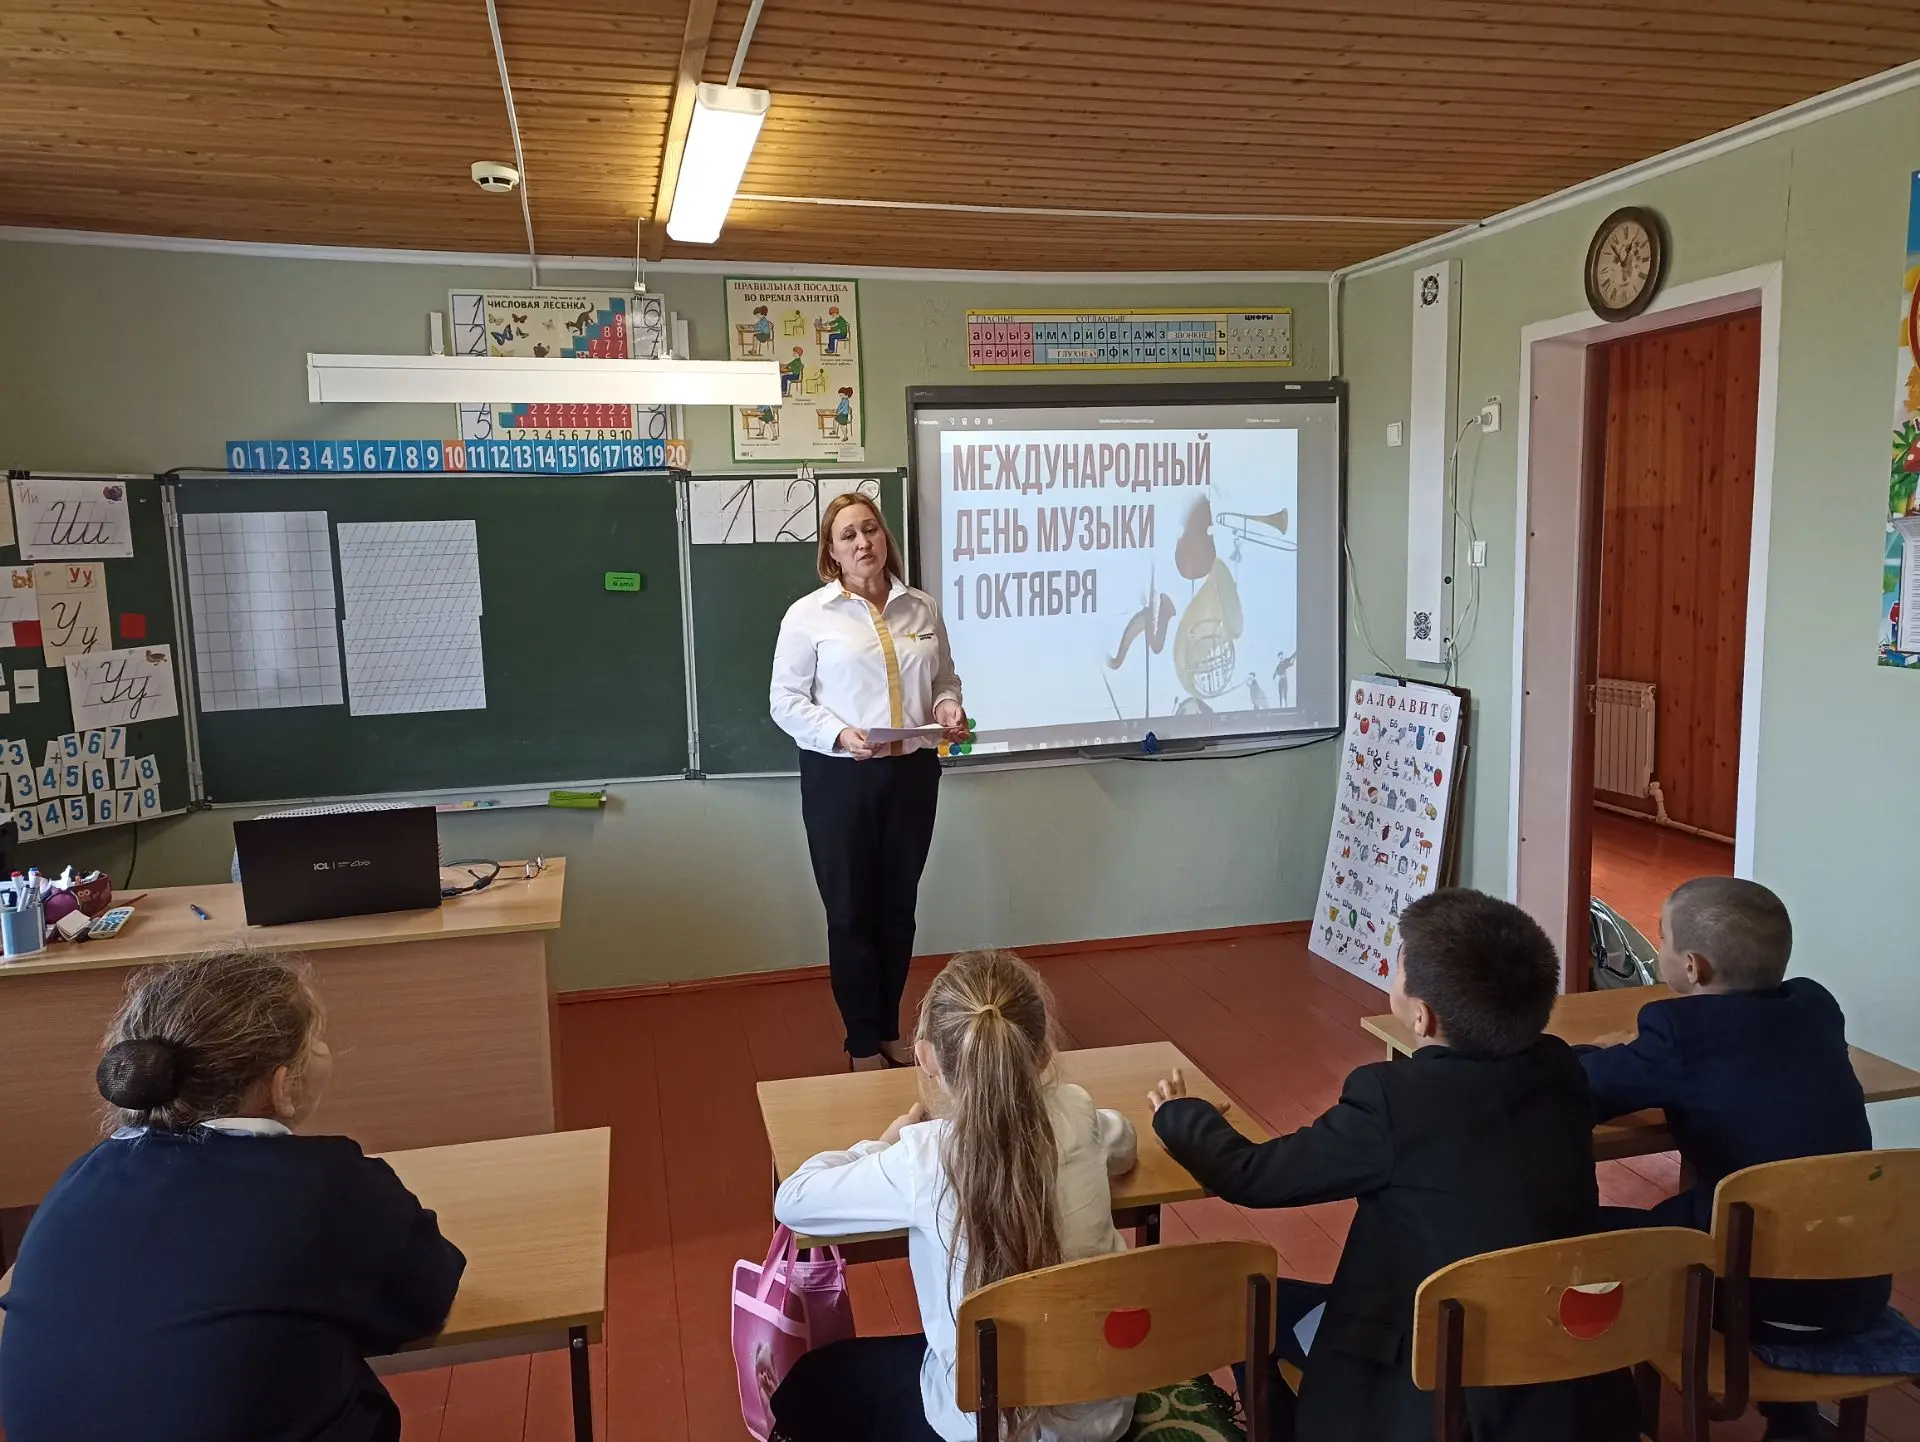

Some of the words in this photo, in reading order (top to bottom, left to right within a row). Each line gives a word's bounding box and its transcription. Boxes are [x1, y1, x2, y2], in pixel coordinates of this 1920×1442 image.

[734, 282, 801, 291] ПРАВИЛЬНАЯ
[803, 283, 848, 293] ПОСАДКА
[744, 294, 757, 302] ВО
[759, 293, 791, 302] ВРЕМЯ
[794, 293, 840, 303] ЗАНЯТИЙ
[487, 300, 540, 309] ЧИСЛОВАЯ
[543, 301, 586, 310] ЛЕСЕНКА
[603, 326, 611, 338] 8
[616, 326, 624, 338] 8
[615, 314, 623, 326] 9
[591, 340, 598, 350] 7
[605, 340, 612, 350] 7
[617, 340, 624, 351] 7
[506, 430, 512, 440] 1
[519, 430, 526, 440] 2
[533, 430, 539, 440] 3
[545, 430, 552, 440] 4
[559, 430, 566, 440] 5
[571, 430, 578, 440] 6
[585, 430, 591, 440] 7
[597, 430, 604, 440] 8
[609, 430, 616, 440] 9
[620, 430, 632, 440] 10
[231, 447, 245, 470] 0
[254, 447, 266, 470] 1
[276, 447, 290, 470] 2
[299, 447, 311, 470] 3
[320, 446, 334, 469] 4
[342, 446, 354, 469] 5
[363, 446, 376, 469] 6
[384, 446, 396, 469] 7
[405, 446, 419, 469] 8
[426, 446, 439, 469] 9
[445, 446, 465, 469] 10
[467, 445, 486, 468] 11
[490, 445, 510, 468] 12
[513, 445, 532, 468] 13
[536, 445, 556, 468] 14
[558, 445, 577, 468] 15
[580, 445, 600, 468] 16
[602, 445, 621, 468] 17
[624, 445, 644, 467] 18
[645, 444, 665, 467] 19
[667, 445, 687, 466] 20
[952, 432, 1212, 495] МЕЖДУНАРОДНЫЙ
[774, 478, 818, 543] 2
[952, 507, 1028, 562] ДЕНЬ
[1036, 504, 1154, 553] МУЗЫКИ
[953, 574, 965, 620] 1
[975, 568, 1097, 619] ОКТЯБРЯ
[1366, 691, 1439, 717] АЛФАВИТ
[8, 743, 24, 765] 3
[63, 736, 78, 758] 5
[88, 733, 102, 754] 6
[110, 728, 121, 750] 7
[17, 774, 33, 797] 3
[42, 767, 57, 789] 4
[66, 765, 79, 787] 5
[91, 768, 104, 790] 6
[120, 758, 131, 780] 7
[140, 759, 154, 779] 8
[18, 810, 33, 831] 3
[46, 803, 60, 824] 4
[70, 799, 84, 820] 5
[100, 799, 112, 820] 6
[123, 791, 133, 813] 7
[143, 788, 156, 809] 8
